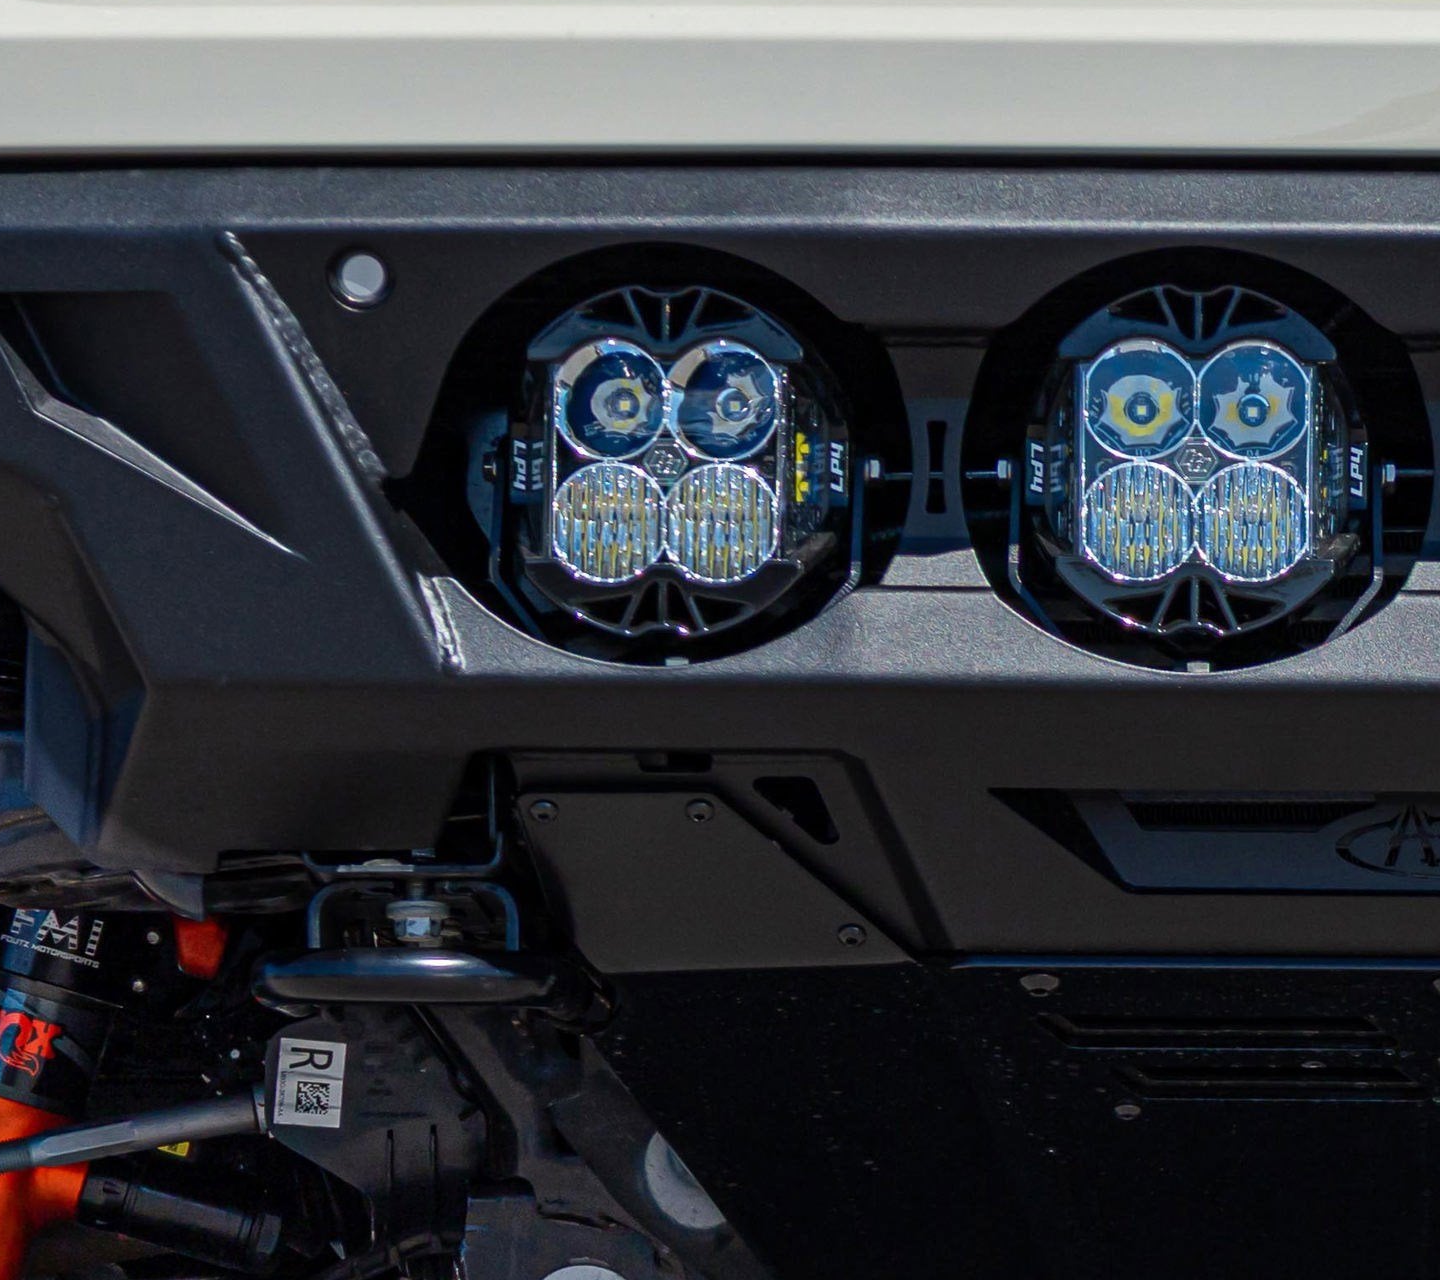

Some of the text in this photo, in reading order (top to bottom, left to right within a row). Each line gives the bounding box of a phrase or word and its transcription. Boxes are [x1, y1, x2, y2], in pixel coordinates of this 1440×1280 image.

[513, 440, 526, 490] LP4
[830, 442, 843, 493] LP4
[1030, 442, 1044, 493] LP4
[1350, 446, 1363, 497] LP4
[0, 933, 100, 969] FOUTZ MOTORSPORTS
[289, 1047, 333, 1070] R
